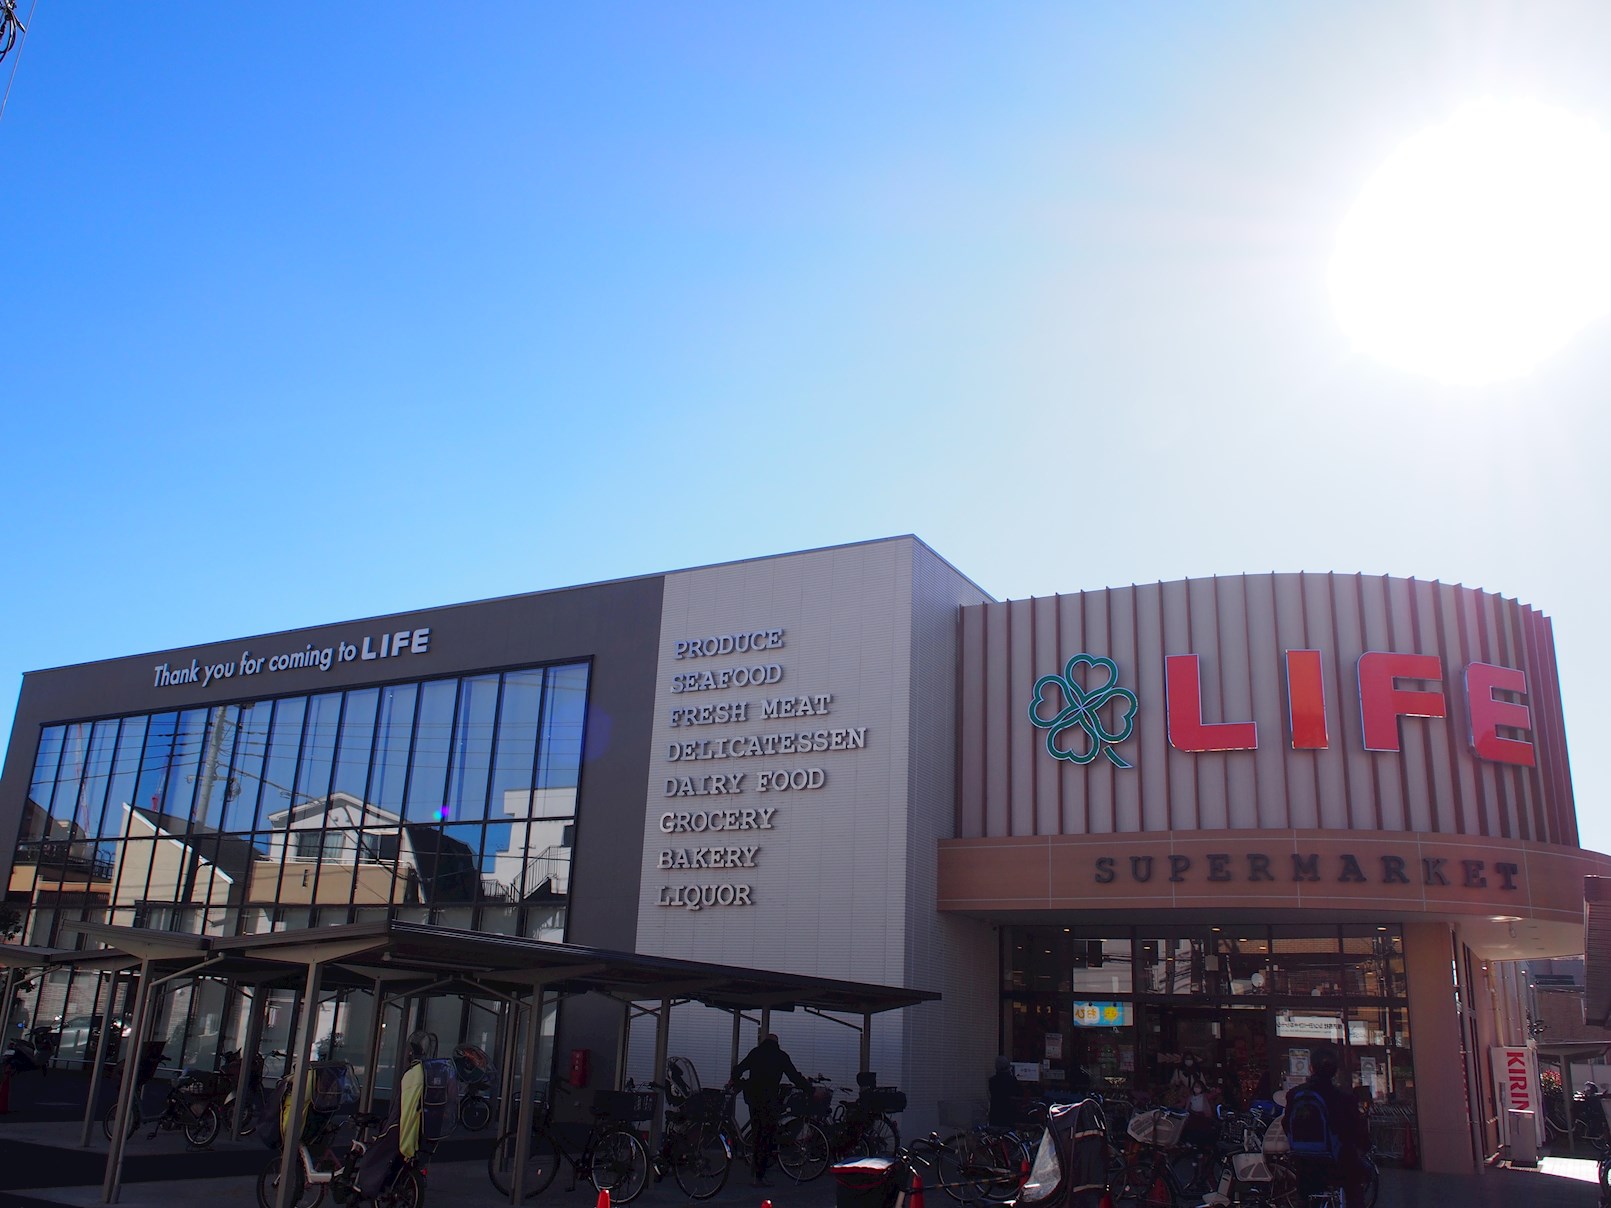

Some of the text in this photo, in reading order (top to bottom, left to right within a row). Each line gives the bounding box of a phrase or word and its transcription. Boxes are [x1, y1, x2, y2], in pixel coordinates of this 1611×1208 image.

[154, 627, 431, 687] Thank you for coming to LIFE
[673, 628, 784, 660] PRODUCE
[671, 663, 783, 693] SEAFOOD
[669, 693, 831, 727] FRESH MEAT
[1164, 648, 1537, 768] LIFE
[666, 727, 867, 762] DELICATESSEN
[664, 768, 825, 797] DAIRY FOOD
[659, 807, 776, 833] GROCERY
[657, 846, 758, 869] BAKERY
[1094, 853, 1519, 891] SUPERMARKET
[655, 884, 752, 910] LIQUOR
